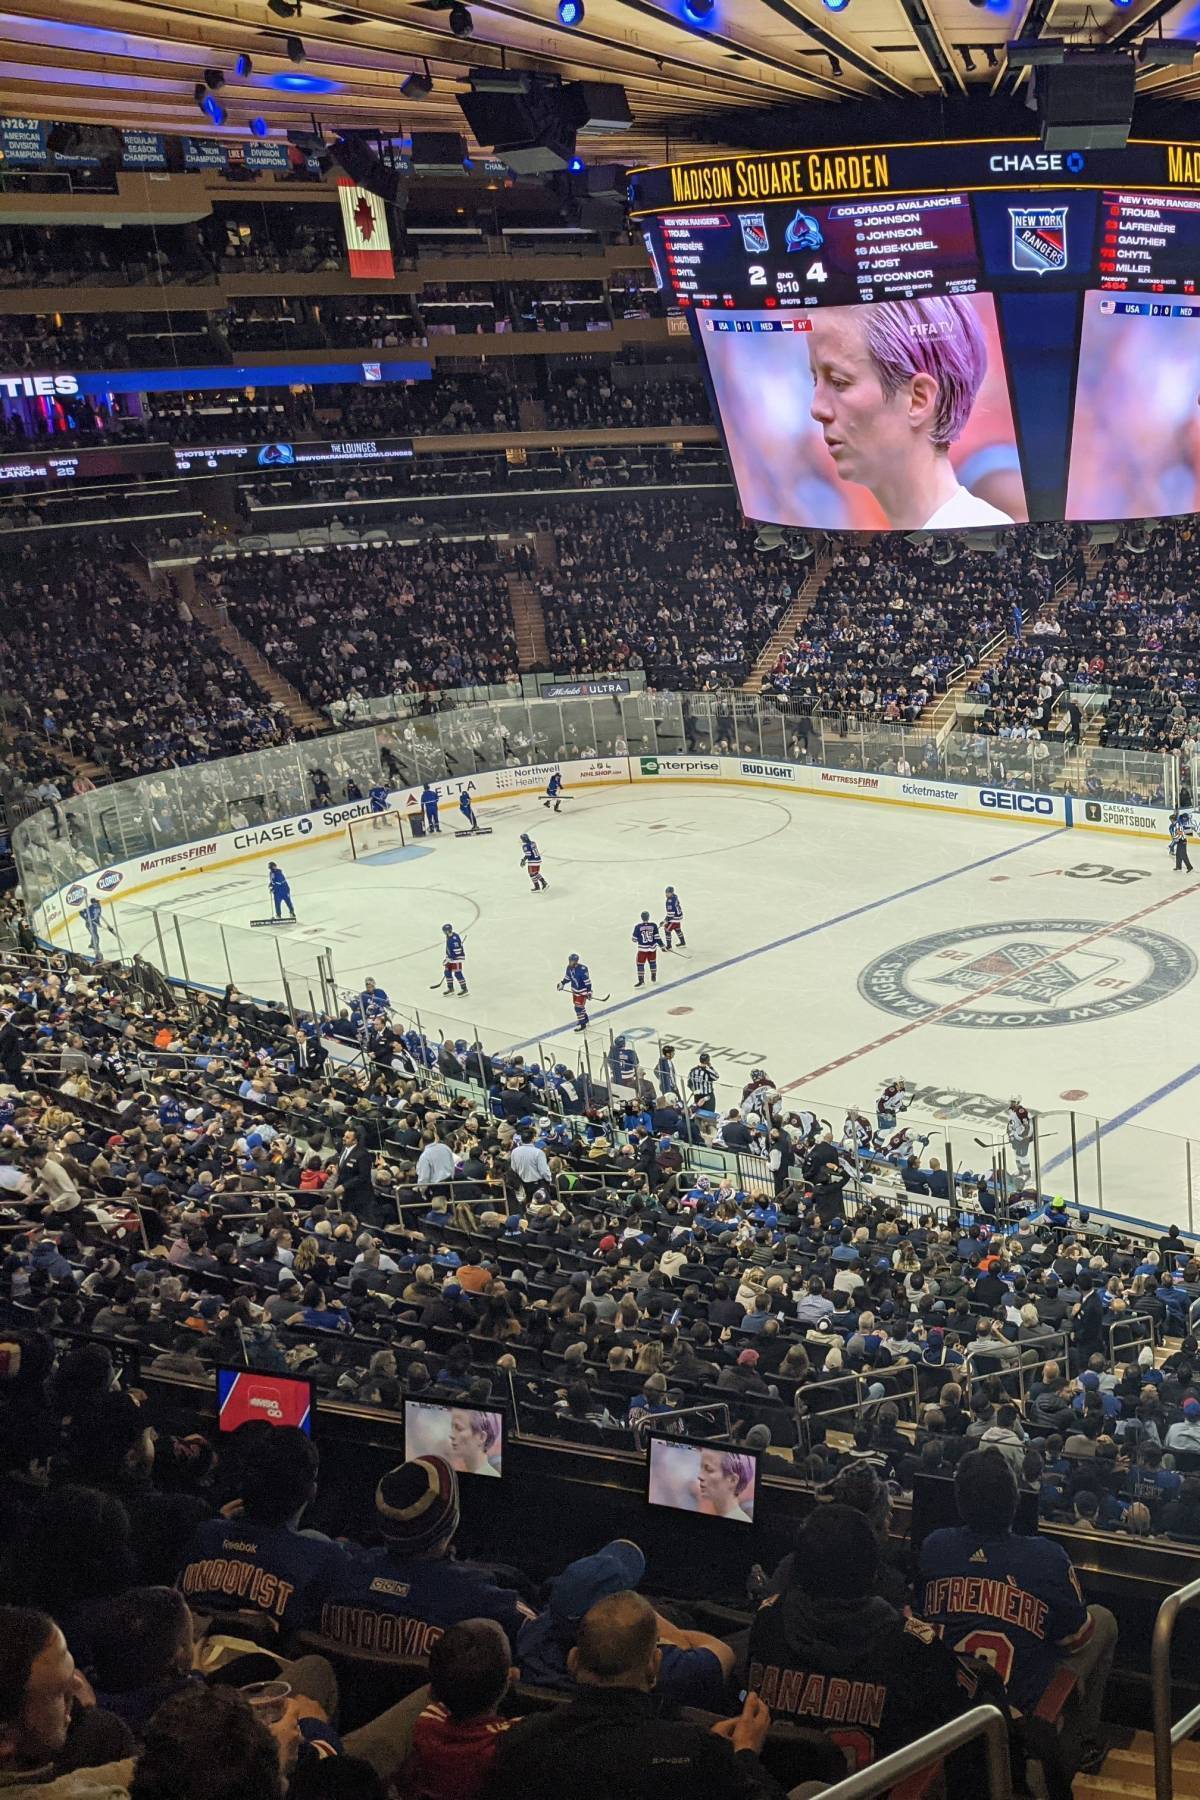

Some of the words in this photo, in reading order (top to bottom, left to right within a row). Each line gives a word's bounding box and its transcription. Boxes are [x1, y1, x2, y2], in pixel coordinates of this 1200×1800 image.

[4, 132, 40, 142] AMERICAN
[124, 136, 158, 145] REGULAR
[8, 142, 39, 150] DIVISION
[128, 145, 156, 154] SEASON
[4, 150, 47, 159] CHAMPIONS
[123, 154, 164, 162] CHAMPIONS
[186, 154, 226, 164] CHAMPIONS
[251, 150, 280, 158] DIVISION
[246, 156, 287, 166] CHAMPIONS
[990, 154, 1063, 172] CHASE
[672, 166, 731, 202] MADISON
[736, 160, 802, 198] SQUARE
[808, 153, 889, 192] GARDEN
[837, 204, 895, 216] COLORADO
[896, 196, 962, 212] AVALANCHE
[1118, 196, 1141, 204] NEW
[1142, 197, 1166, 207] YORK
[854, 218, 863, 227] 3
[864, 212, 920, 226] JOHNSON
[1120, 208, 1160, 218] TROUBA
[1015, 214, 1037, 227] NEW
[1038, 214, 1063, 227] YORK
[856, 232, 866, 241] 6
[866, 227, 922, 240] JOHNSON
[1119, 222, 1176, 233] LAFRENIÈRE
[869, 240, 938, 255] AUBE-KUBEL
[1021, 230, 1064, 266] RANGERS
[1118, 236, 1166, 247] GAUTHIER
[1116, 250, 1152, 260] CHYTIL
[858, 261, 870, 270] 17
[871, 258, 900, 268] JOST
[1116, 264, 1151, 274] MILLER
[748, 266, 768, 286] 2
[806, 262, 828, 283] 4
[856, 276, 873, 284] 25
[874, 270, 934, 282] O'CONNOR
[776, 281, 800, 293] 9:10
[948, 284, 976, 294] .536
[1125, 304, 1140, 314] USA
[1153, 306, 1158, 314] 0
[1164, 306, 1170, 315] 0
[1180, 308, 1192, 316] NED
[718, 322, 730, 331] USA
[760, 322, 774, 331] NED
[908, 322, 938, 336] FIFA
[938, 320, 956, 335] TV
[0, 376, 78, 398] TIES
[174, 450, 204, 458] SHOTS
[216, 448, 248, 456] PERIOD
[342, 442, 377, 454] LOUNGES
[296, 450, 413, 462] NEWYORKRANGERS.COM/LOUNGES
[176, 461, 191, 470] 19
[208, 460, 218, 468] 6
[56, 467, 76, 476] 25
[589, 684, 623, 694] ULTRA
[514, 764, 560, 777] Northwell
[647, 758, 719, 774] enterprise
[742, 764, 762, 776] BUD
[763, 765, 794, 780] LIGHT
[515, 776, 542, 788] Health
[820, 772, 879, 789] MATTRESSFIRM
[436, 780, 476, 798] ELTA
[902, 782, 958, 801] ticketmaster
[979, 790, 1054, 814] GEICO
[323, 804, 372, 827] Spectru
[1102, 804, 1134, 814] CAESARS
[1102, 812, 1156, 830] SPORTSBOOK
[234, 823, 295, 850] CHASE
[140, 843, 217, 873] MATTRESSFIRM
[1064, 862, 1152, 884] 5G
[872, 962, 931, 1016] RANGERS
[1068, 994, 1144, 1020] NEW
[950, 1012, 1052, 1026] YORK
[267, 1408, 282, 1418] GO
[222, 1538, 258, 1554] Reebok
[184, 1558, 294, 1616] UNDQVIST
[373, 1579, 408, 1594] CCM
[924, 1574, 1049, 1640] AFRENIÈRE
[321, 1602, 445, 1656] LUNDQVIS
[750, 1662, 886, 1728] PANARIN
